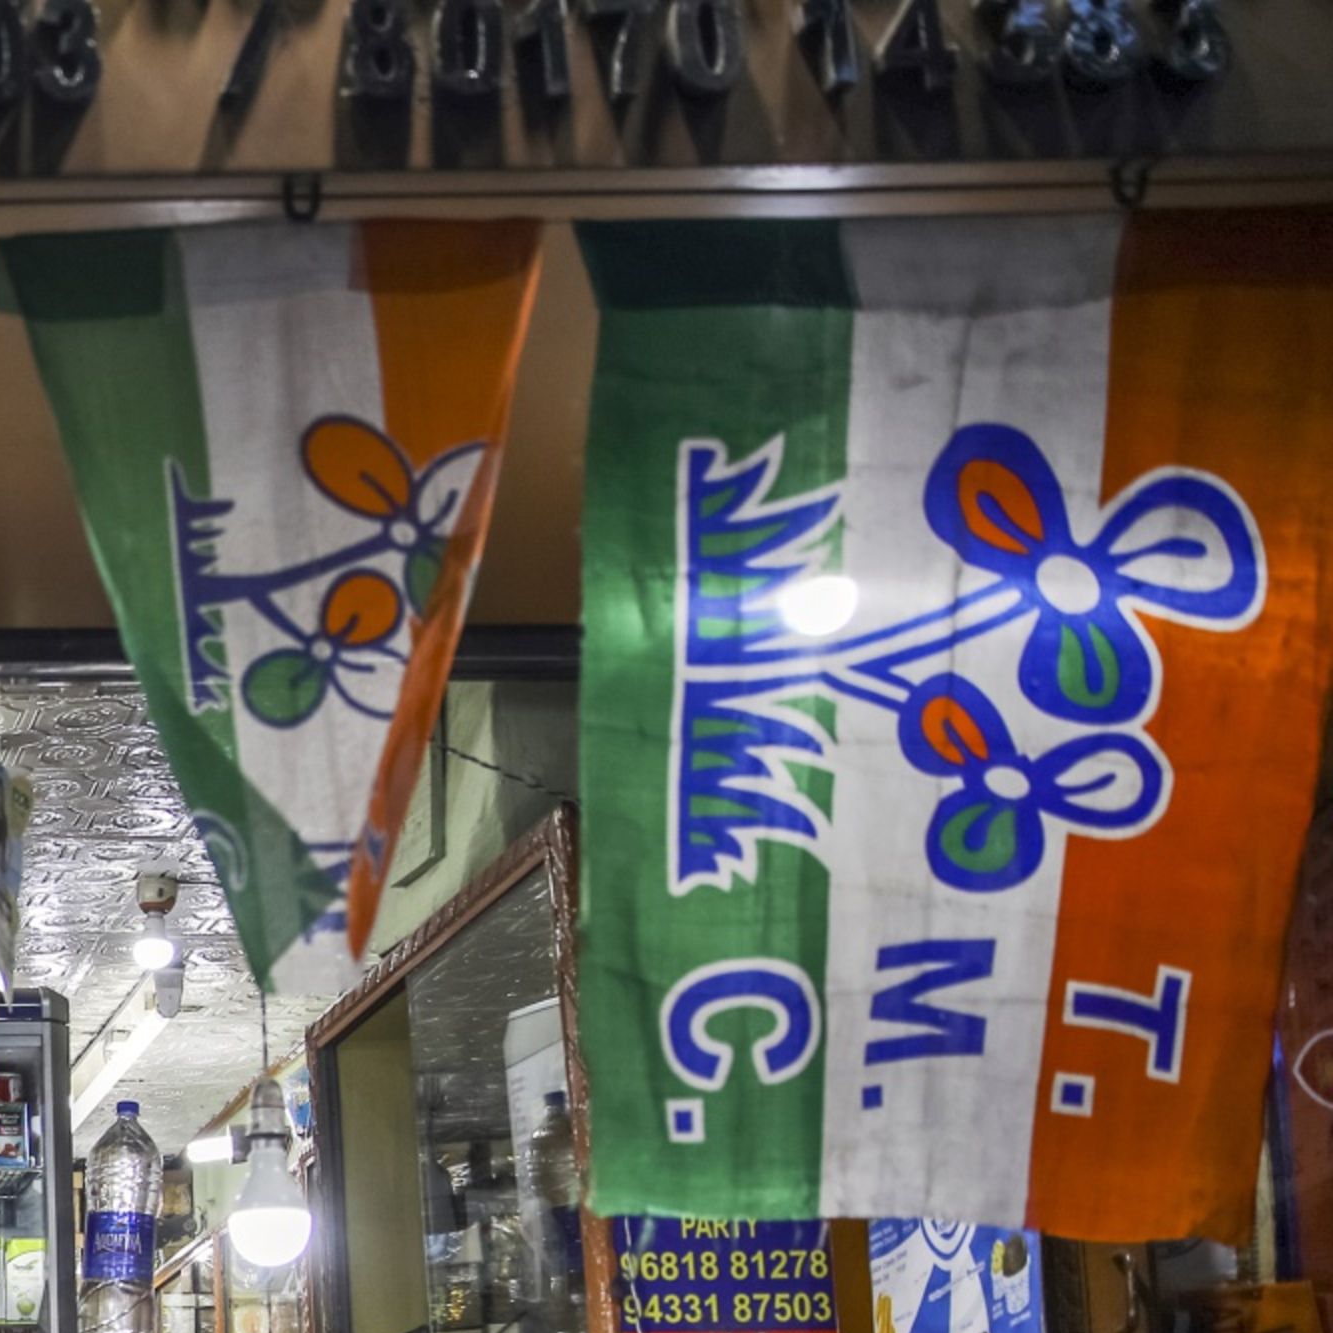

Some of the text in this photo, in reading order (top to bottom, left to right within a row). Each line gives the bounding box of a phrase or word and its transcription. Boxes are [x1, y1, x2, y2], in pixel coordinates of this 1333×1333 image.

[680, 1215, 758, 1239] PARTY
[620, 1249, 829, 1282] 96818 81278
[622, 1292, 832, 1325] 94331 87503
